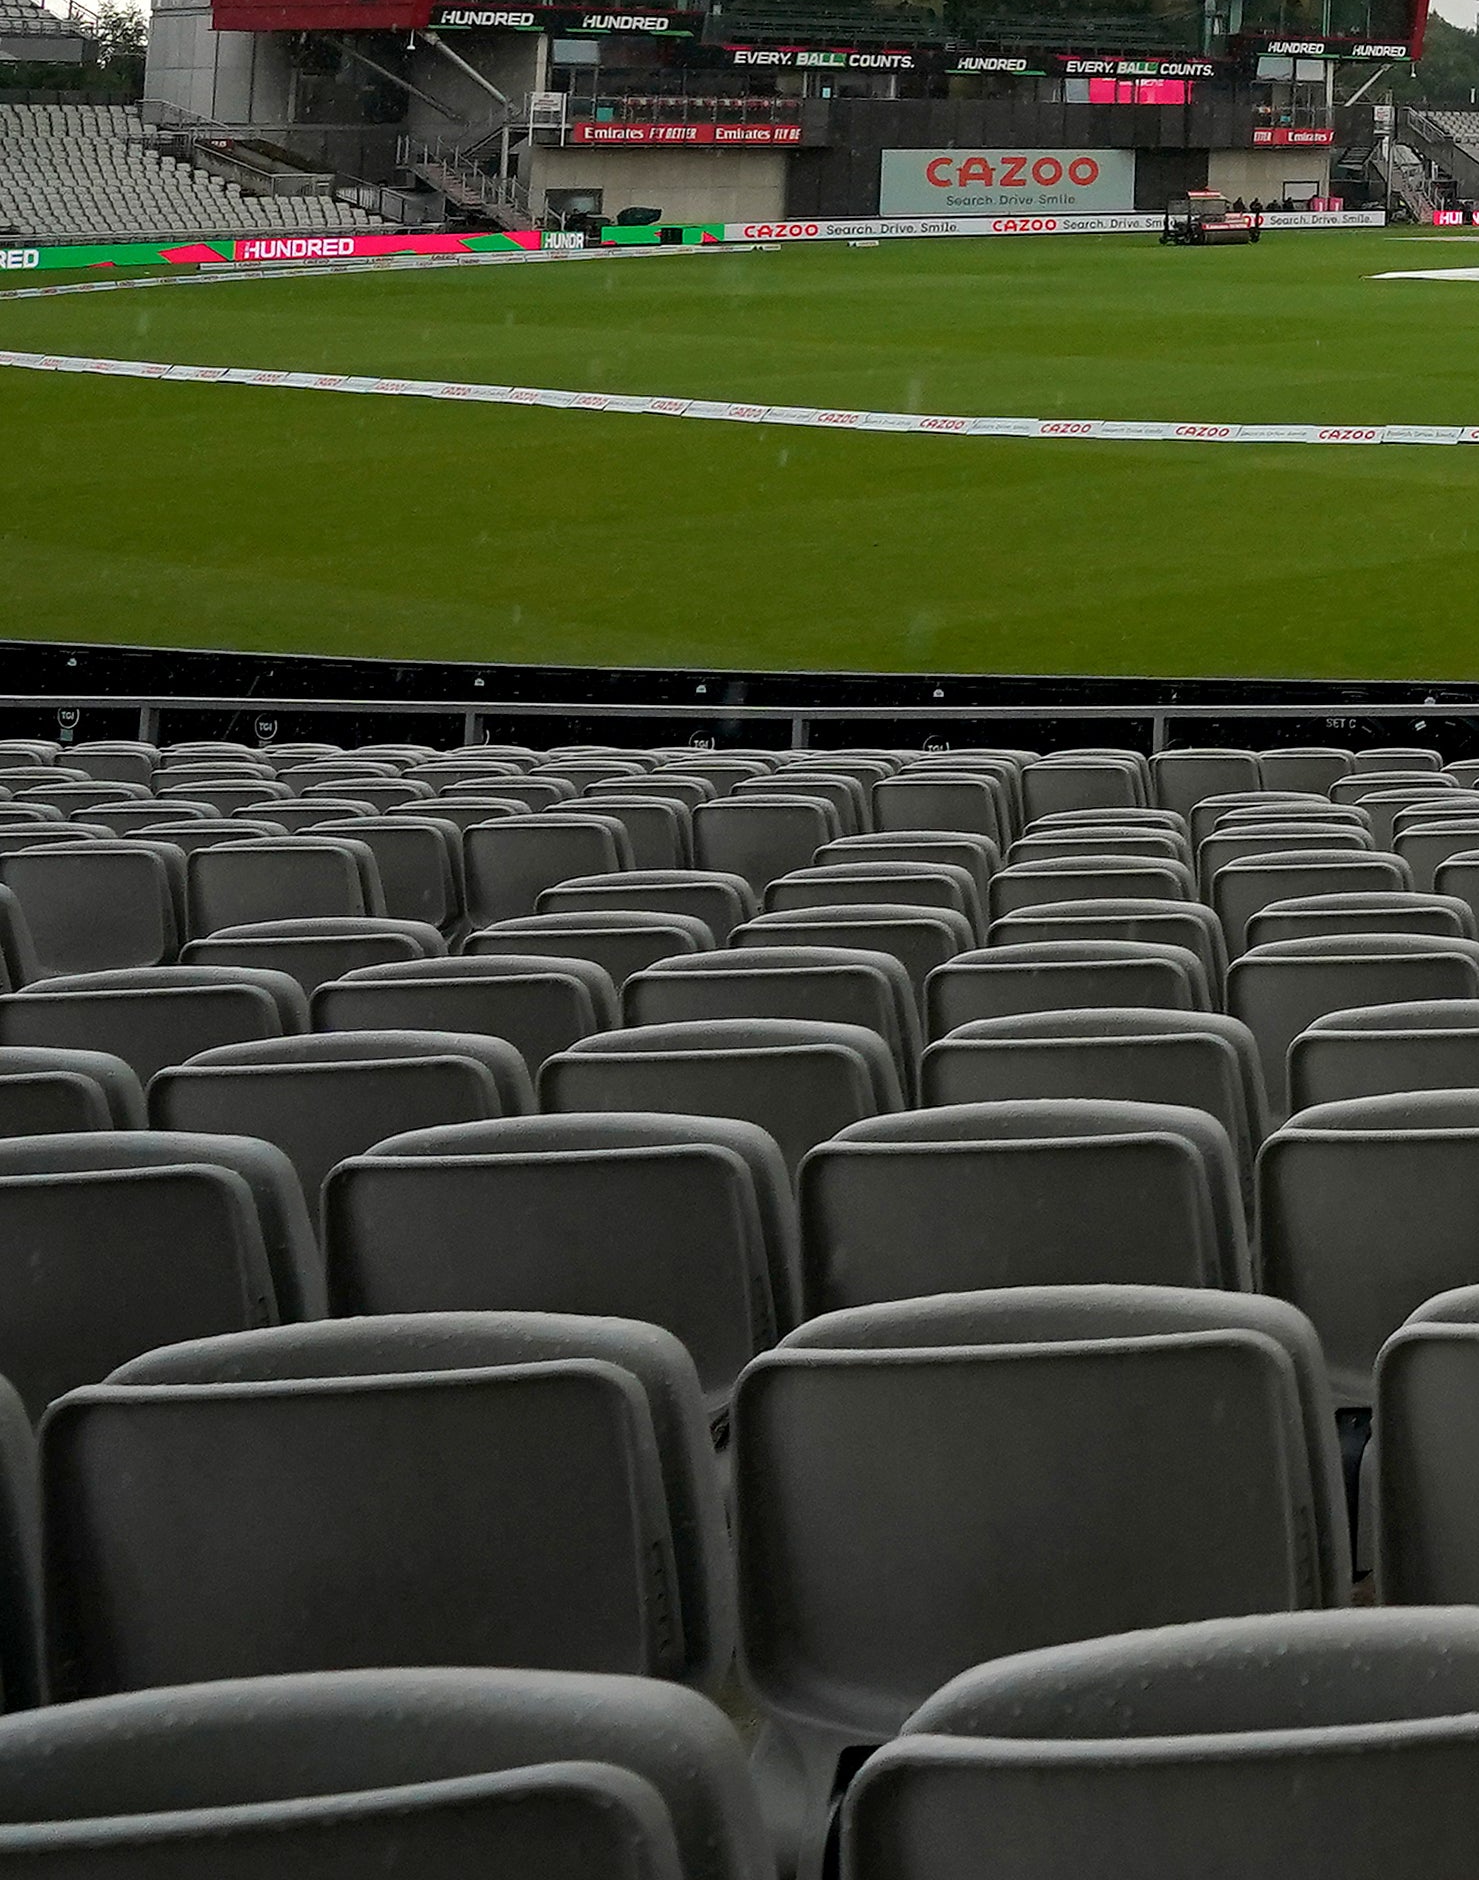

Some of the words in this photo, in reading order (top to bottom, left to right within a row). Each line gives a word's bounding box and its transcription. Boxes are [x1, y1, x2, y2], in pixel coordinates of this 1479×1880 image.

[441, 10, 534, 27] HUNDRED
[582, 14, 670, 32] HUNDRED
[1267, 41, 1325, 55] HUNDRED
[1352, 44, 1407, 58] HUNDRED
[733, 51, 792, 66] EVERY.
[848, 54, 916, 69] COUNTS.
[958, 57, 1027, 71] HUNDRED
[1066, 60, 1114, 75] EVERY.
[1160, 62, 1215, 77] COUNTS.
[584, 126, 645, 140] Emirates
[715, 127, 771, 140] Emirates
[926, 156, 1099, 188] CAZOO
[992, 219, 1057, 232] CAZOO
[1063, 219, 1106, 231] Search.
[1270, 214, 1308, 226] Search.
[1311, 214, 1339, 225] Drive.
[1342, 213, 1373, 224] Smile.
[744, 224, 819, 239] CAZOO
[826, 223, 876, 236] Search.
[880, 223, 917, 234] Drive.
[920, 222, 960, 233] Smile.
[243, 238, 355, 259] HUNDRED
[1040, 423, 1092, 434] CAZOO
[1176, 426, 1230, 437] CAZOO
[1318, 429, 1376, 441] CAZOO
[1325, 718, 1345, 729] SET
[1348, 718, 1357, 729] C
